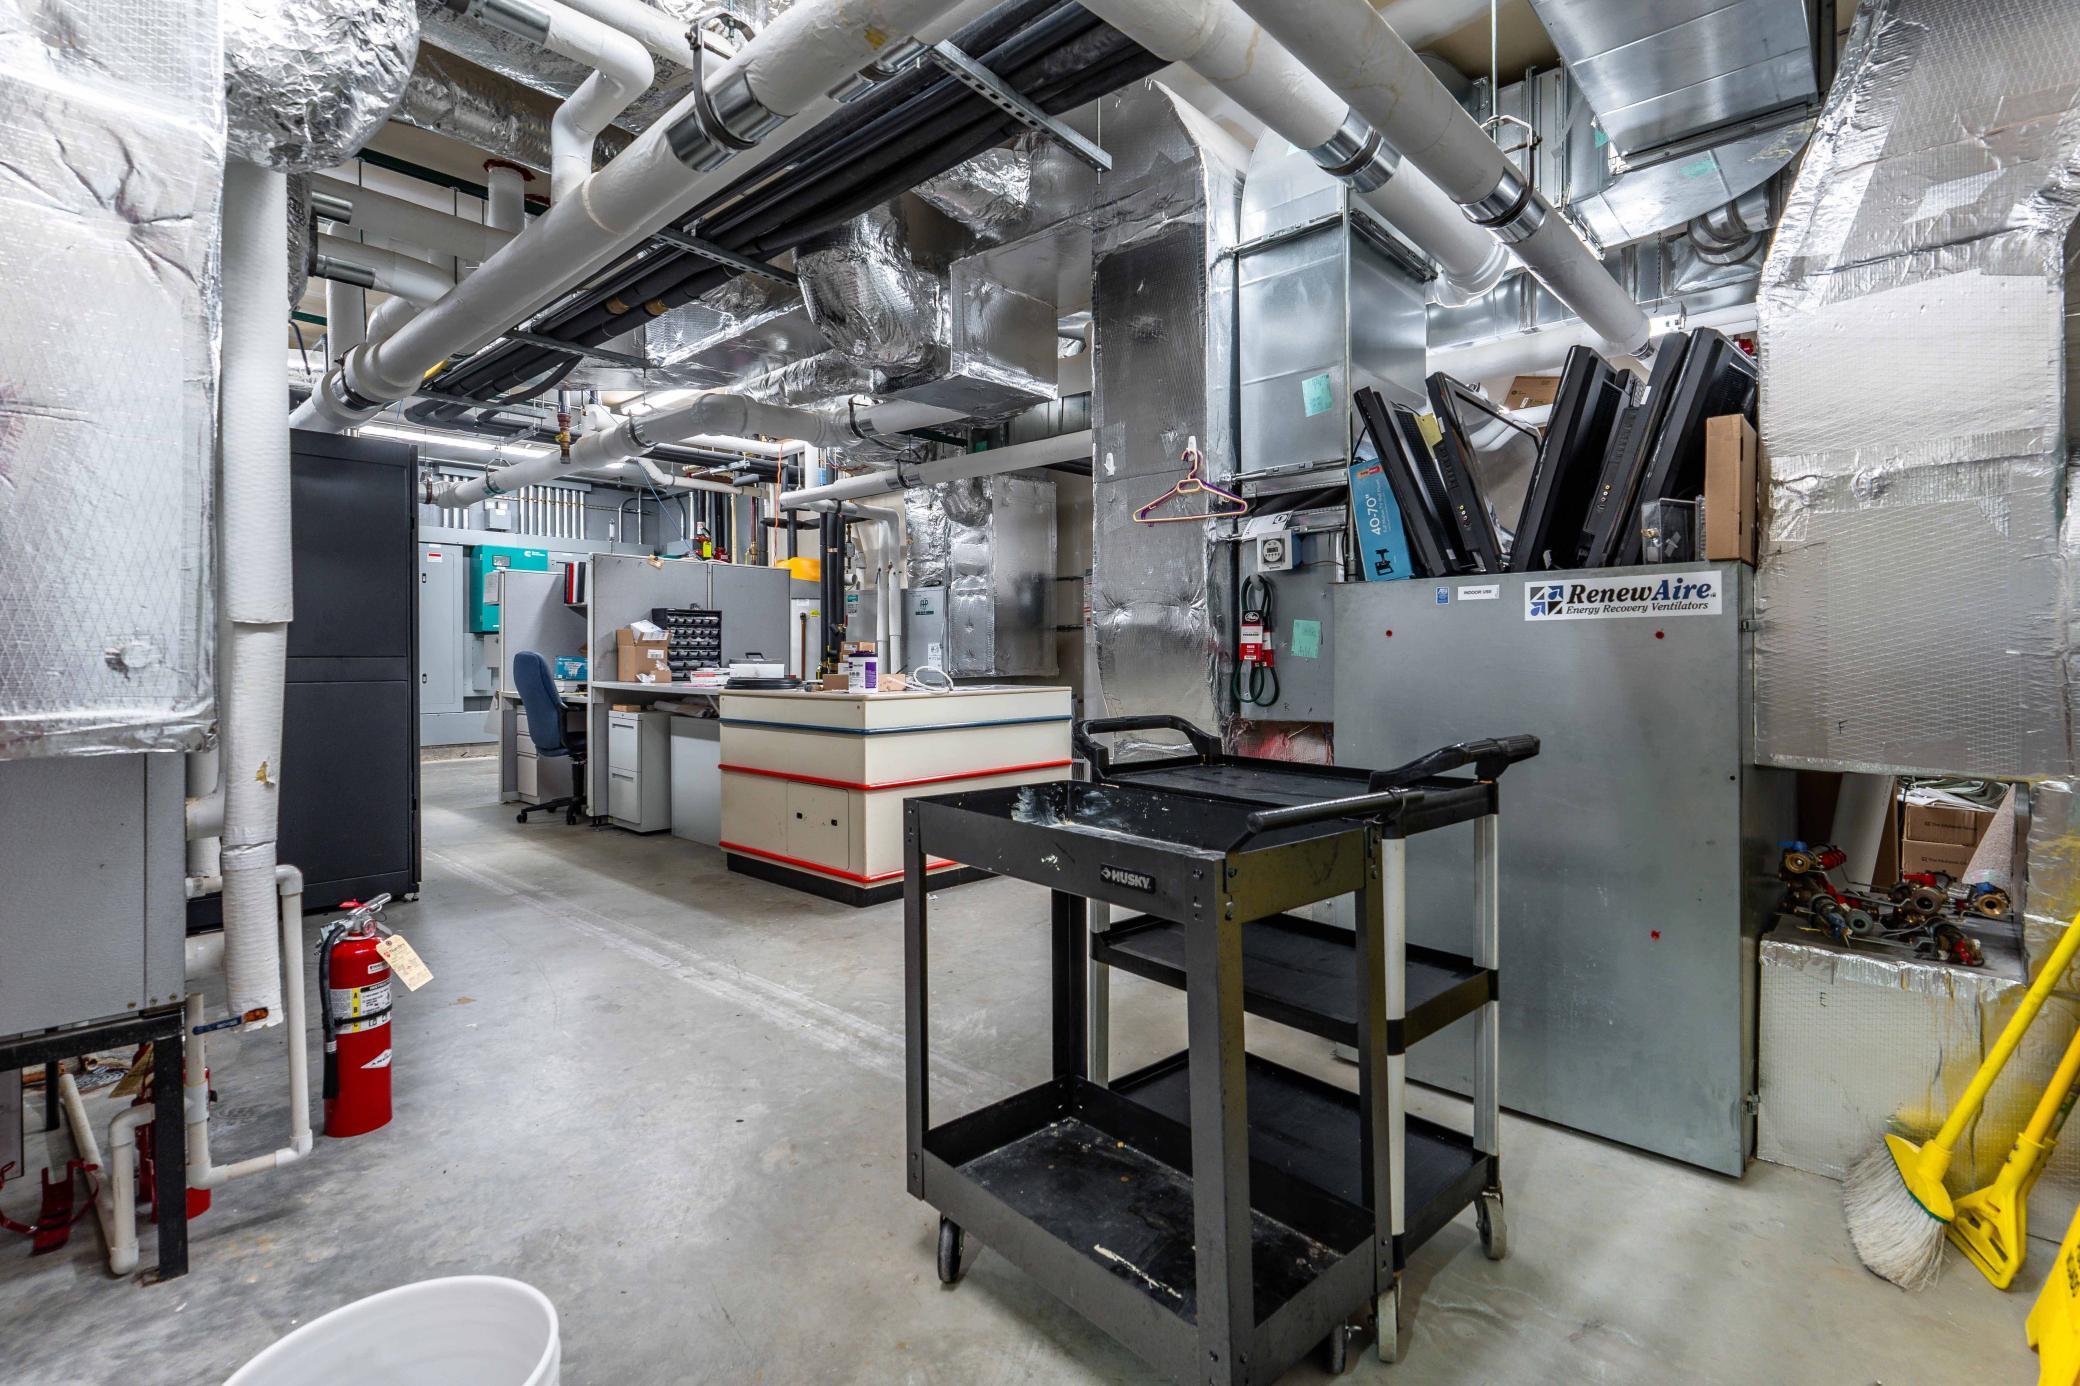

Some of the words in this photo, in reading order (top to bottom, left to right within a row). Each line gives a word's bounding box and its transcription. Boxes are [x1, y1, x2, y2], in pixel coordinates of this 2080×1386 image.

[1364, 494, 1381, 535] 40-70"
[1567, 577, 1712, 605] RenewAire
[1566, 605, 1600, 616] Energy
[1603, 604, 1648, 615] Recovery
[1652, 601, 1708, 612] Ventilators
[1111, 869, 1150, 890] HUSKY
